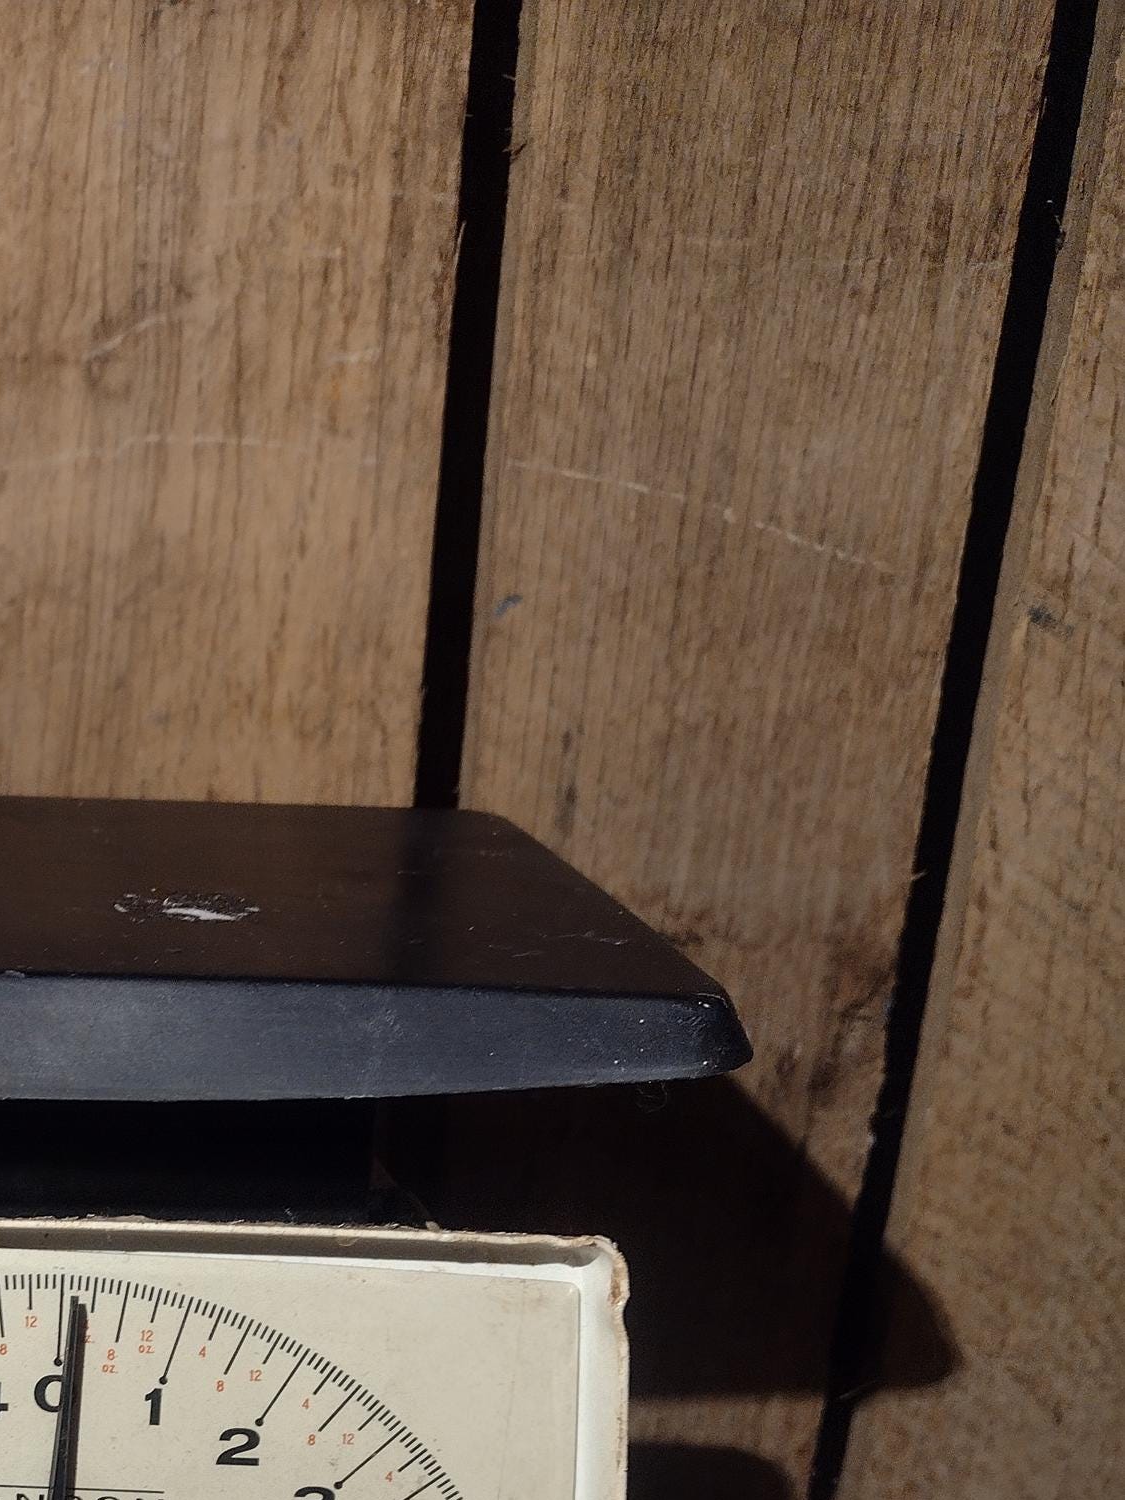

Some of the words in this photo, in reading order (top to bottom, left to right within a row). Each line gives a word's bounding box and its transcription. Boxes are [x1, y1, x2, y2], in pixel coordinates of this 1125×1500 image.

[25, 1316, 37, 1329] 12
[141, 1330, 153, 1342] 12
[0, 1343, 8, 1355] 8
[107, 1349, 115, 1361] 8
[198, 1346, 206, 1358] 4
[250, 1370, 262, 1381] 12
[216, 1380, 224, 1392] 8
[145, 1388, 161, 1425] 1
[302, 1398, 309, 1410] 4
[307, 1434, 316, 1446] 8
[342, 1433, 354, 1445] 12
[216, 1428, 259, 1466] 2
[385, 1471, 393, 1482] 4
